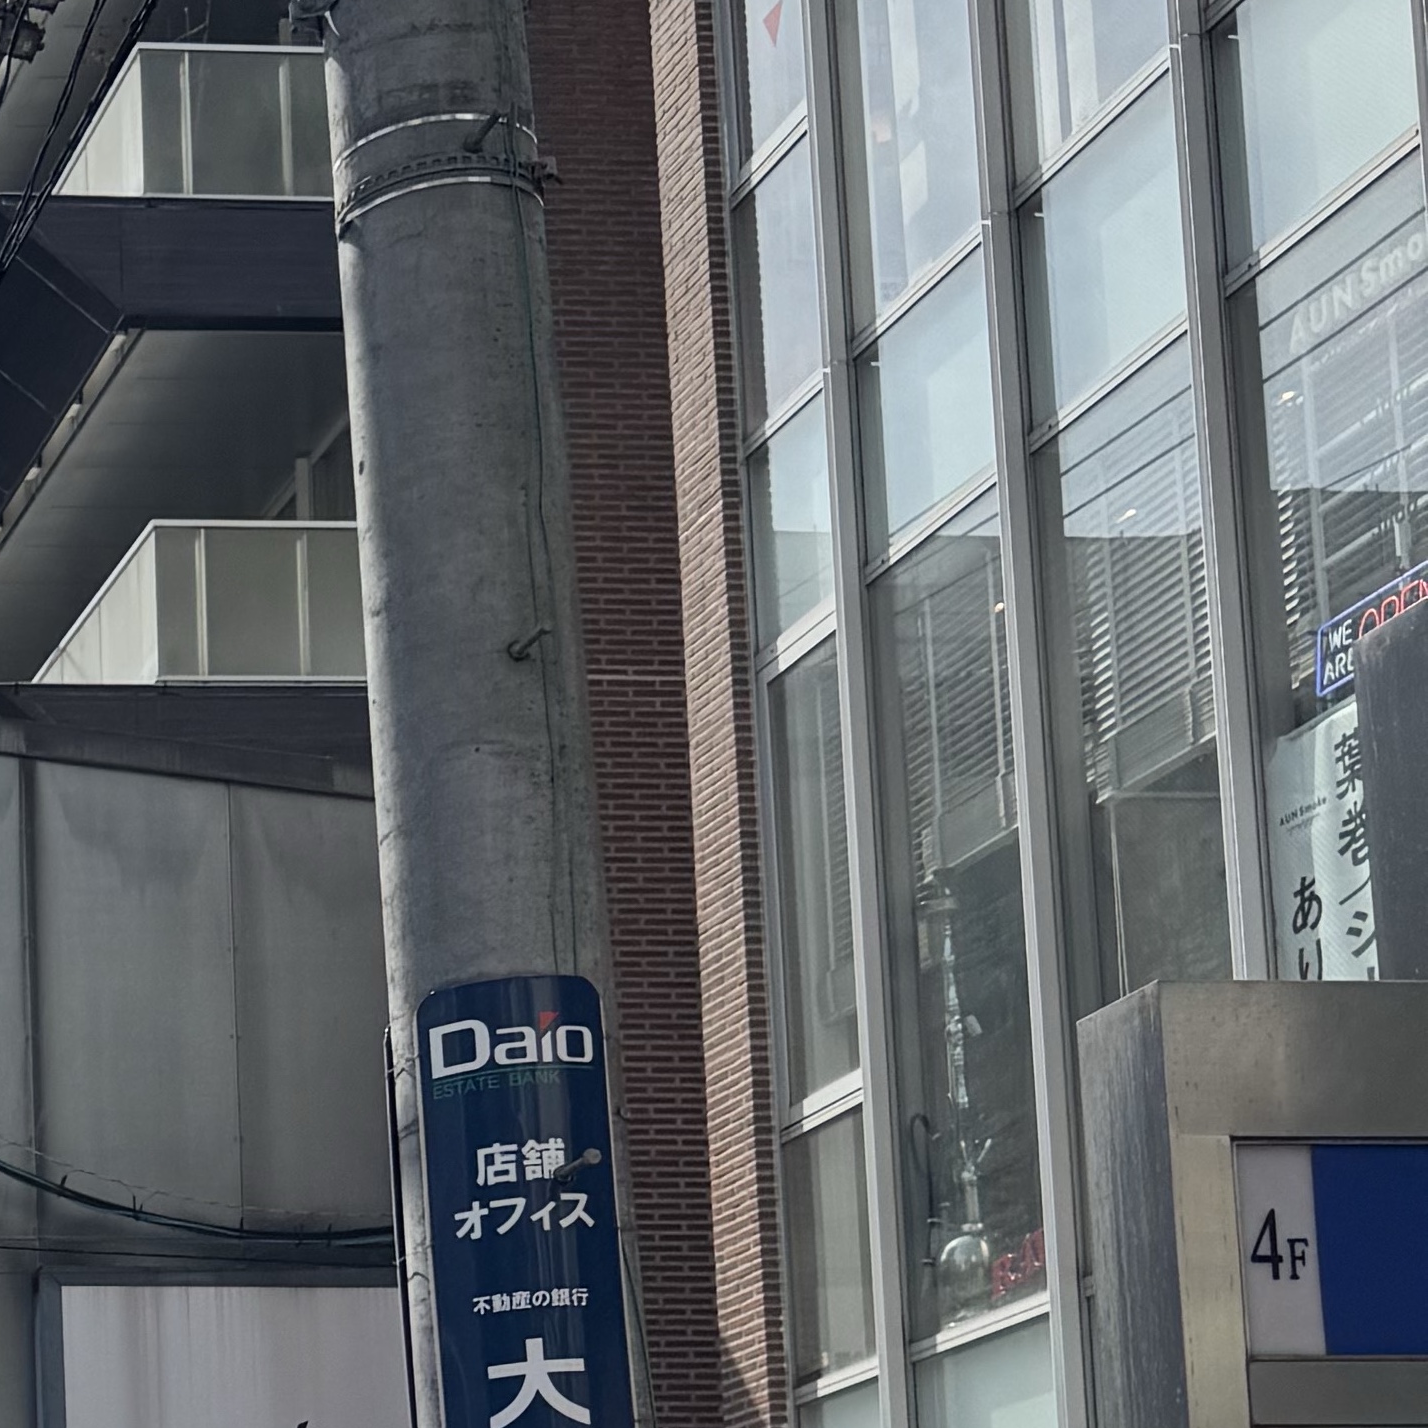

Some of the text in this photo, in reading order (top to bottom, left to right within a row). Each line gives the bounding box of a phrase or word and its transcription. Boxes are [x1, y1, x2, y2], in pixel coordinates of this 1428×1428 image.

[1328, 618, 1353, 652] WE
[428, 1011, 594, 1080] Daio
[432, 1069, 562, 1100] ESTATE BANK
[475, 1136, 566, 1187] 店舗
[453, 1192, 595, 1240] オフィス
[1250, 1208, 1309, 1281] 4F
[472, 1287, 589, 1316] 不動産の銀行
